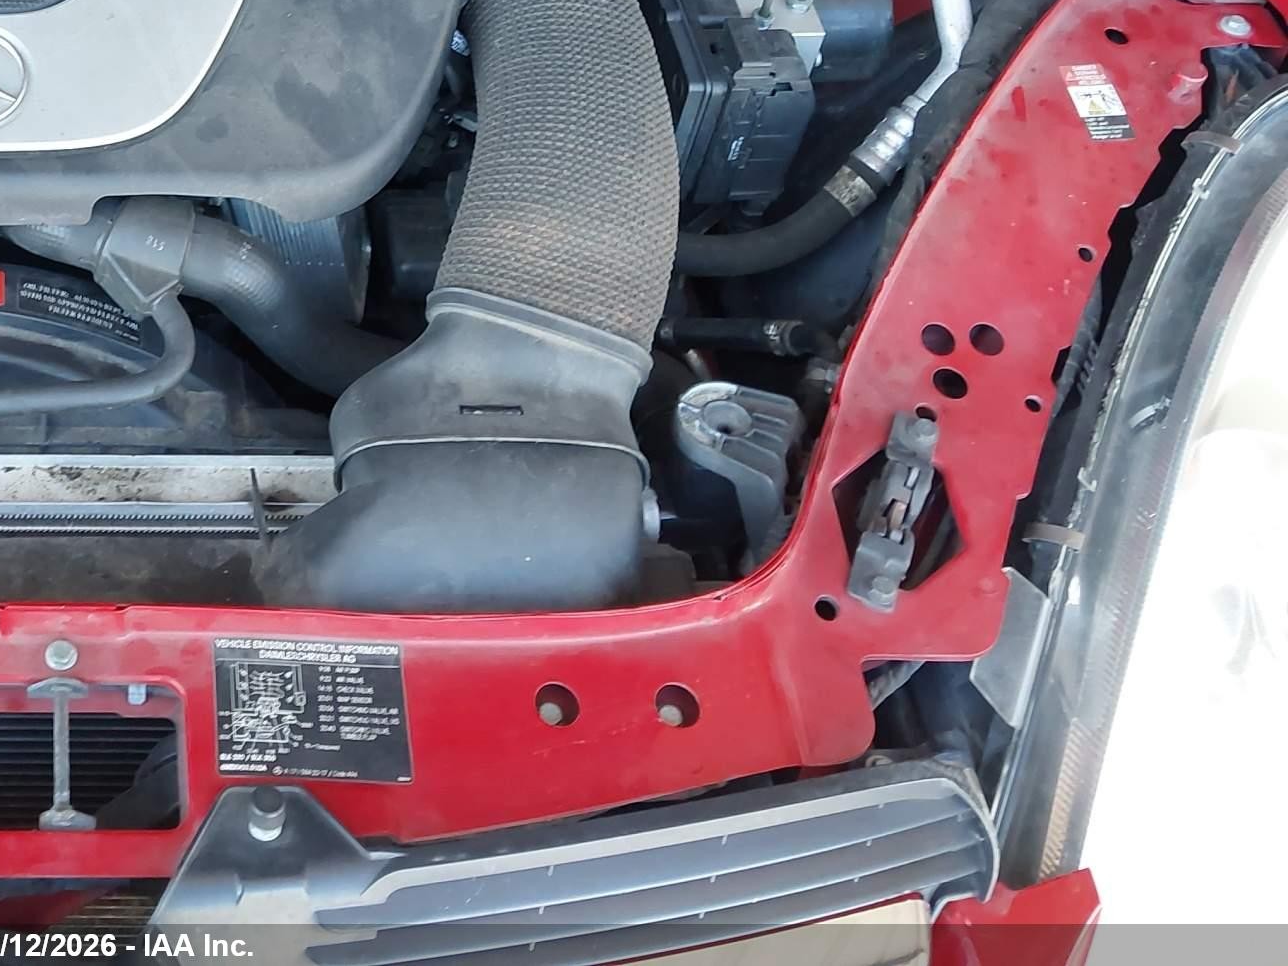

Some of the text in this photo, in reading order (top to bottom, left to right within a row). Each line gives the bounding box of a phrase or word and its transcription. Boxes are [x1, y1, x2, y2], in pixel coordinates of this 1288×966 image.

[215, 639, 399, 655] VEHICLE EMISSION CONTROL INFORMATION
[342, 654, 356, 664] AG
